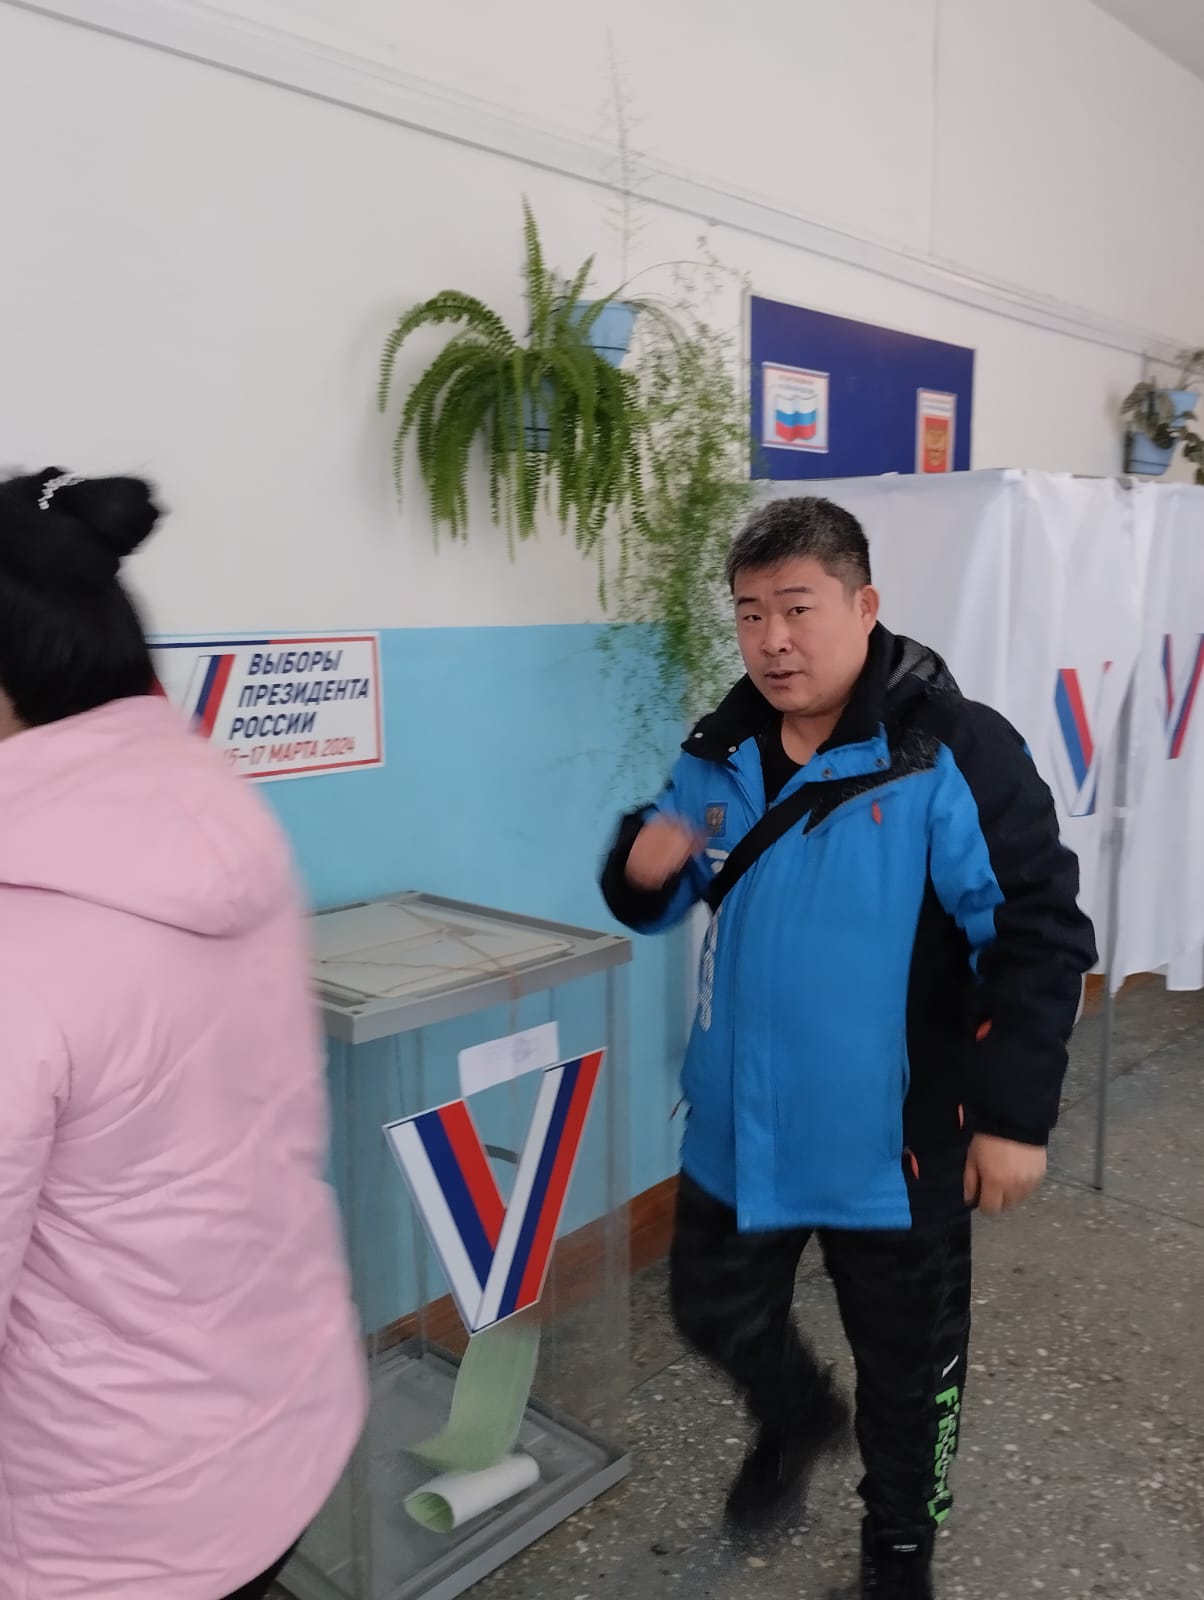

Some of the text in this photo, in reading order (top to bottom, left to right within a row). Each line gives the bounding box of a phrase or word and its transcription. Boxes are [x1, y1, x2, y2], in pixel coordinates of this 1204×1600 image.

[248, 650, 343, 675] ВЫБОРЫ
[239, 679, 370, 708] ПРЕЗИДЕНТА
[229, 712, 317, 741] РОССИИ
[268, 740, 319, 764] МАРТА
